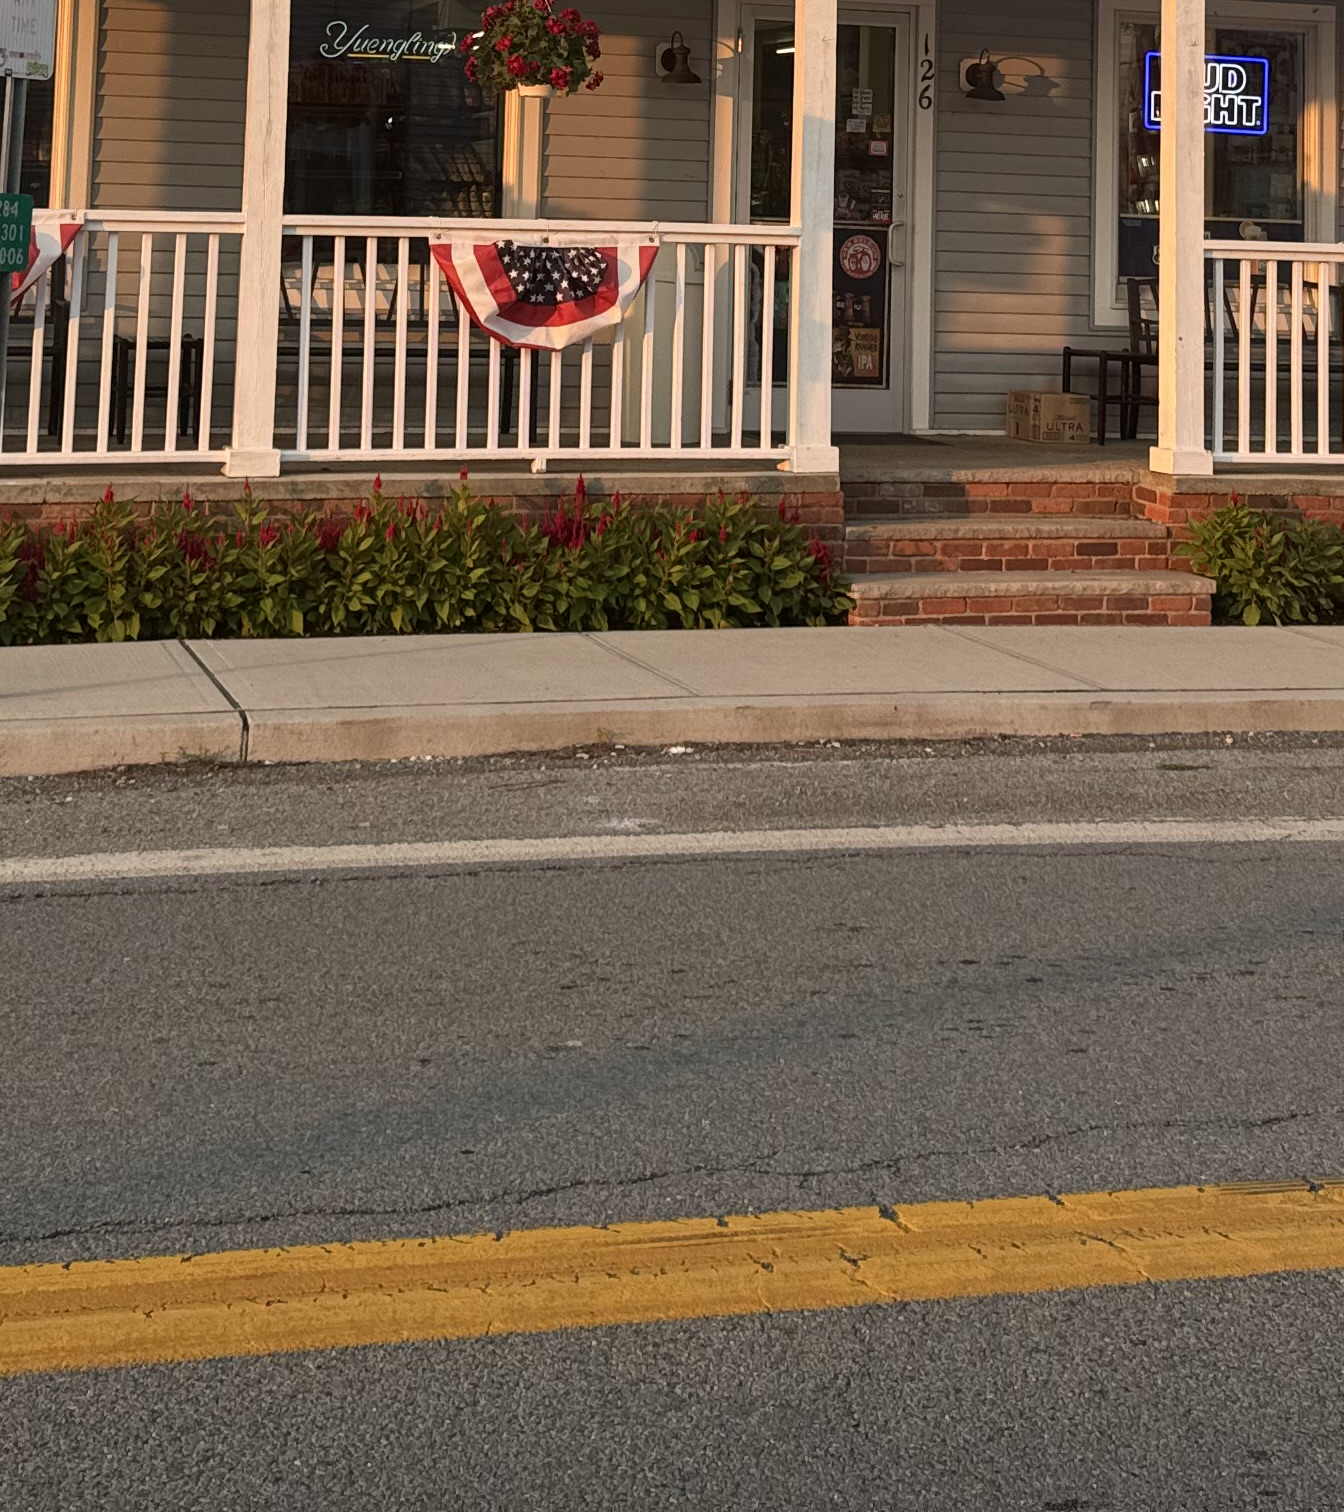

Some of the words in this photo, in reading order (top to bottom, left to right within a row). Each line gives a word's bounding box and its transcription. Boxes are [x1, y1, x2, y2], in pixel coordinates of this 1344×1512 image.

[11, 16, 37, 35] TIME
[320, 21, 447, 63] Yuengling
[918, 32, 935, 110] 126
[1203, 62, 1247, 94] UD
[858, 354, 874, 370] IPA
[1046, 422, 1084, 432] ULTRA
